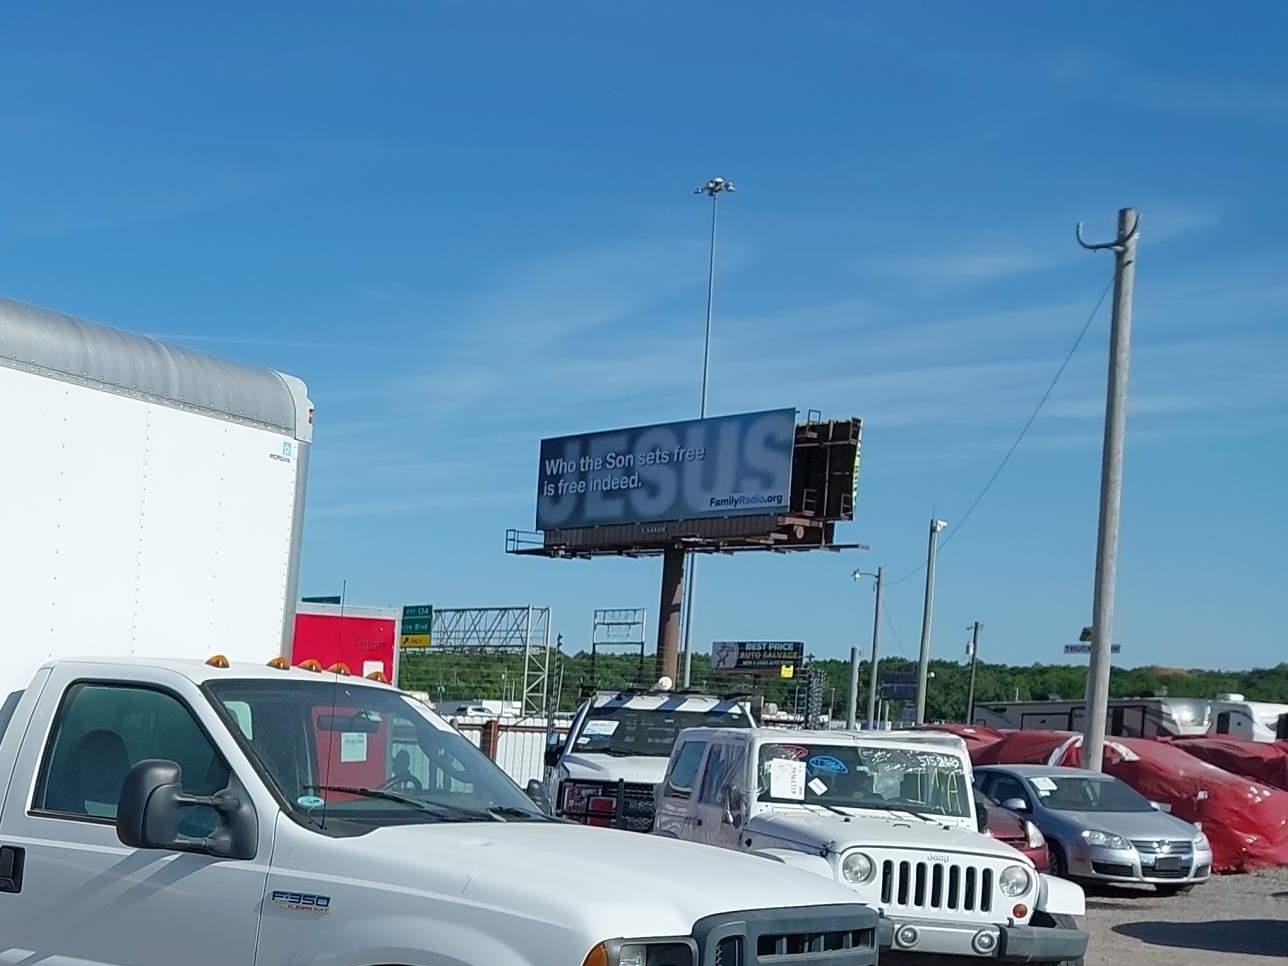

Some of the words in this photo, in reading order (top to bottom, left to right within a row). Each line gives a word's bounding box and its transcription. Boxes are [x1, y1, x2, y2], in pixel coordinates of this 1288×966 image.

[545, 458, 577, 476] Who
[580, 455, 603, 472] the
[605, 452, 634, 469] Son
[637, 448, 670, 466] sets
[673, 445, 705, 463] free
[543, 416, 789, 521] JESUS
[543, 480, 556, 497] is
[558, 479, 586, 496] free
[590, 472, 643, 492] indeed.
[709, 494, 783, 508] FamilyRadio.org
[745, 643, 766, 651] BEST
[768, 643, 794, 651] PRICE
[739, 651, 761, 660] AUTO
[762, 651, 798, 660] SALVAGE
[927, 853, 950, 863] Jeep
